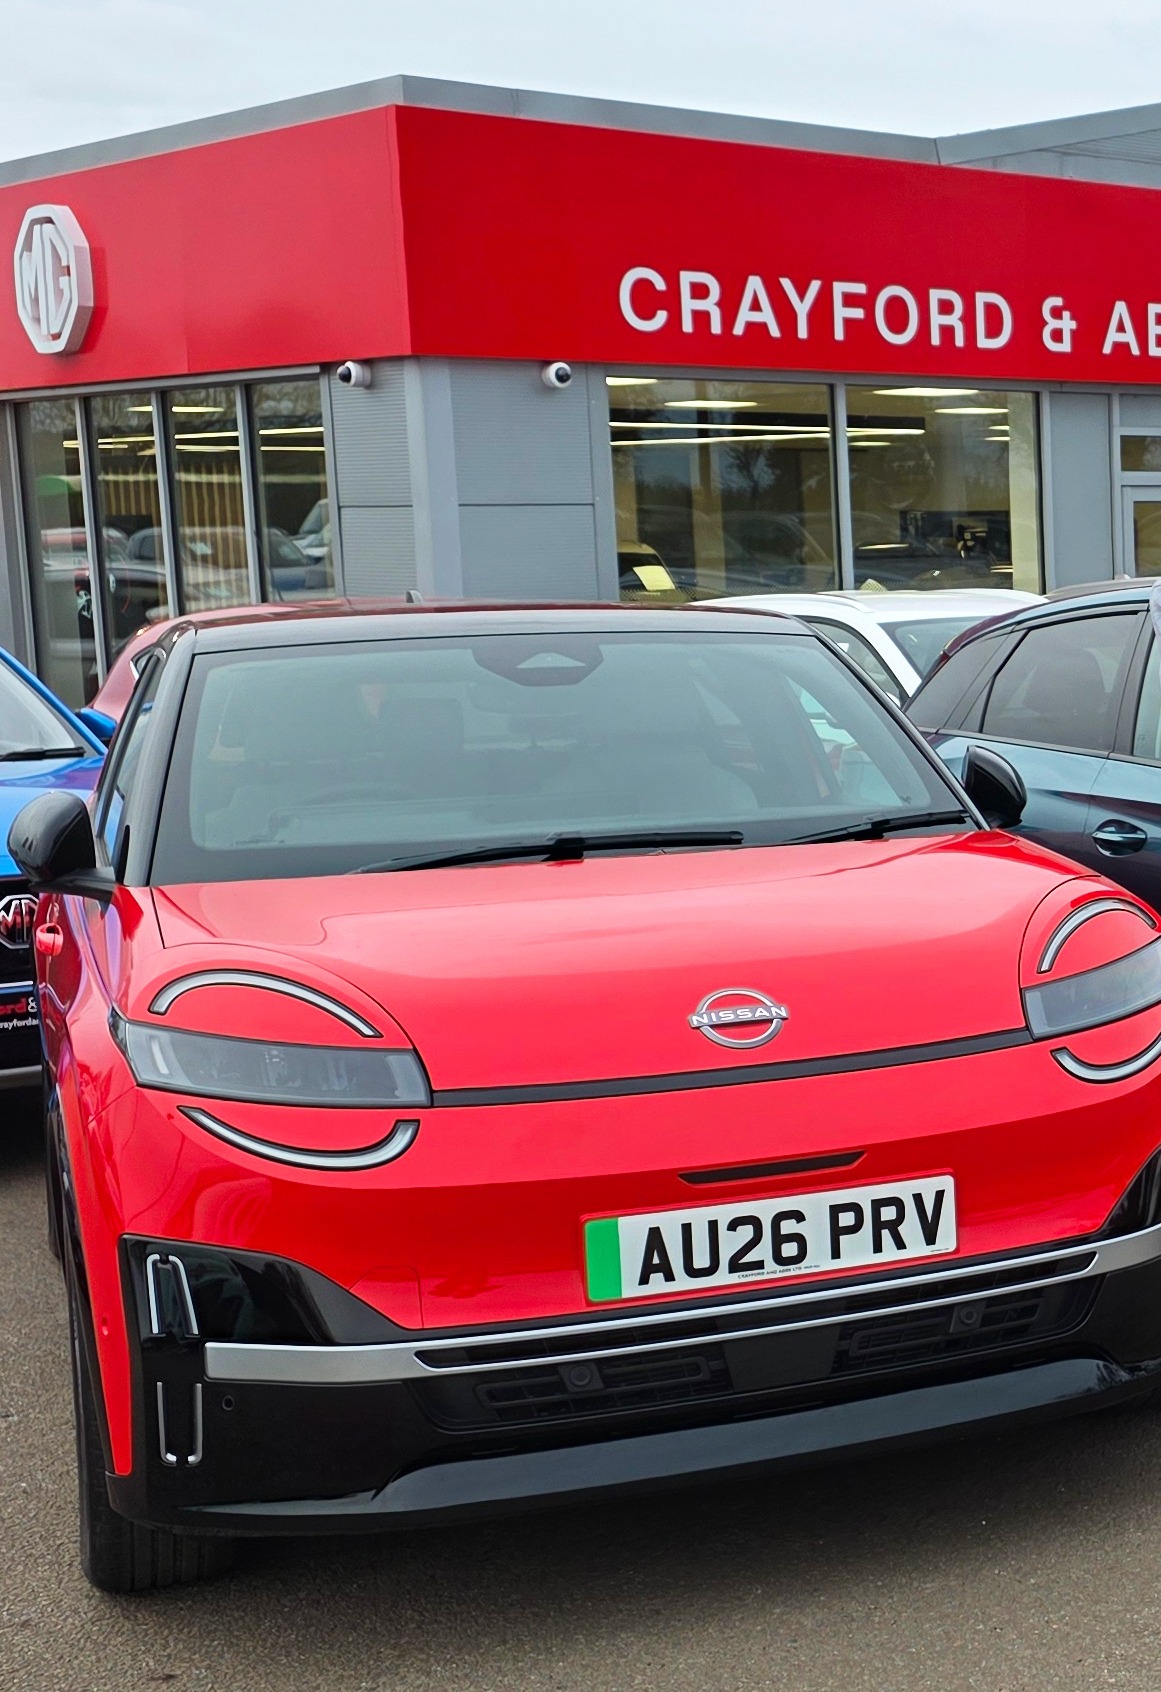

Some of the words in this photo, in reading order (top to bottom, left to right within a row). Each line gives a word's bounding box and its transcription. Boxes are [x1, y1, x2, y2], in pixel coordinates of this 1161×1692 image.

[19, 221, 74, 338] MG
[619, 266, 1013, 349] CRAYFORD
[1041, 296, 1077, 353] &
[691, 1006, 787, 1026] NISSAN
[637, 1209, 808, 1287] AU26
[828, 1189, 946, 1260] PRV
